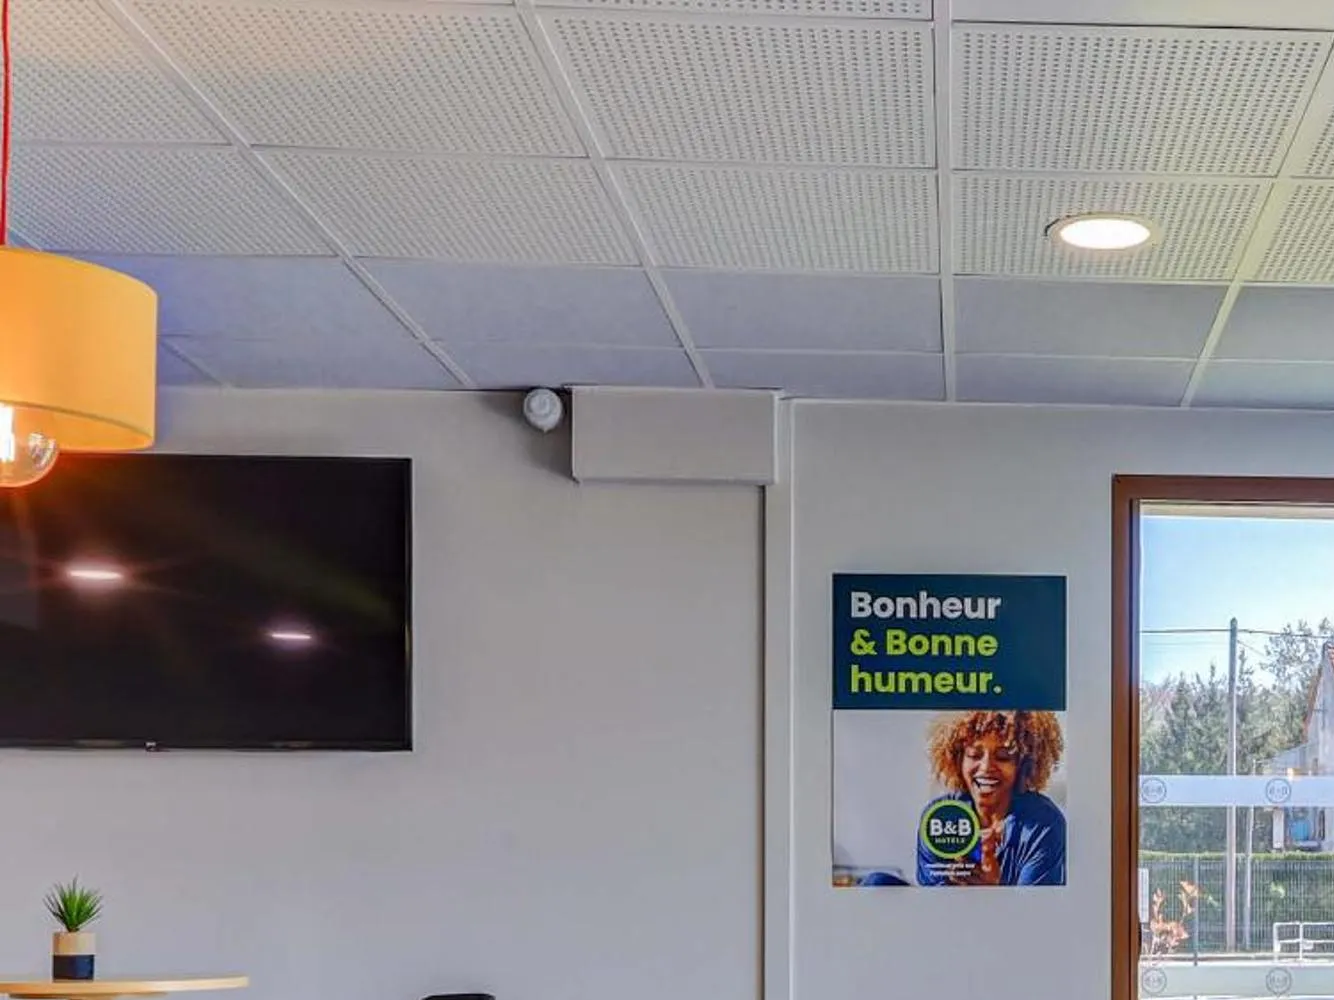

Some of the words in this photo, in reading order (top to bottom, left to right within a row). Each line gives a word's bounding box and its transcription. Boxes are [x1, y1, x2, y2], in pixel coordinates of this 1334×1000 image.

[851, 591, 1002, 619] Bonheur
[850, 629, 877, 656] &
[886, 629, 998, 657] Bonne
[850, 664, 1003, 694] humeur.
[929, 818, 971, 836] B&B
